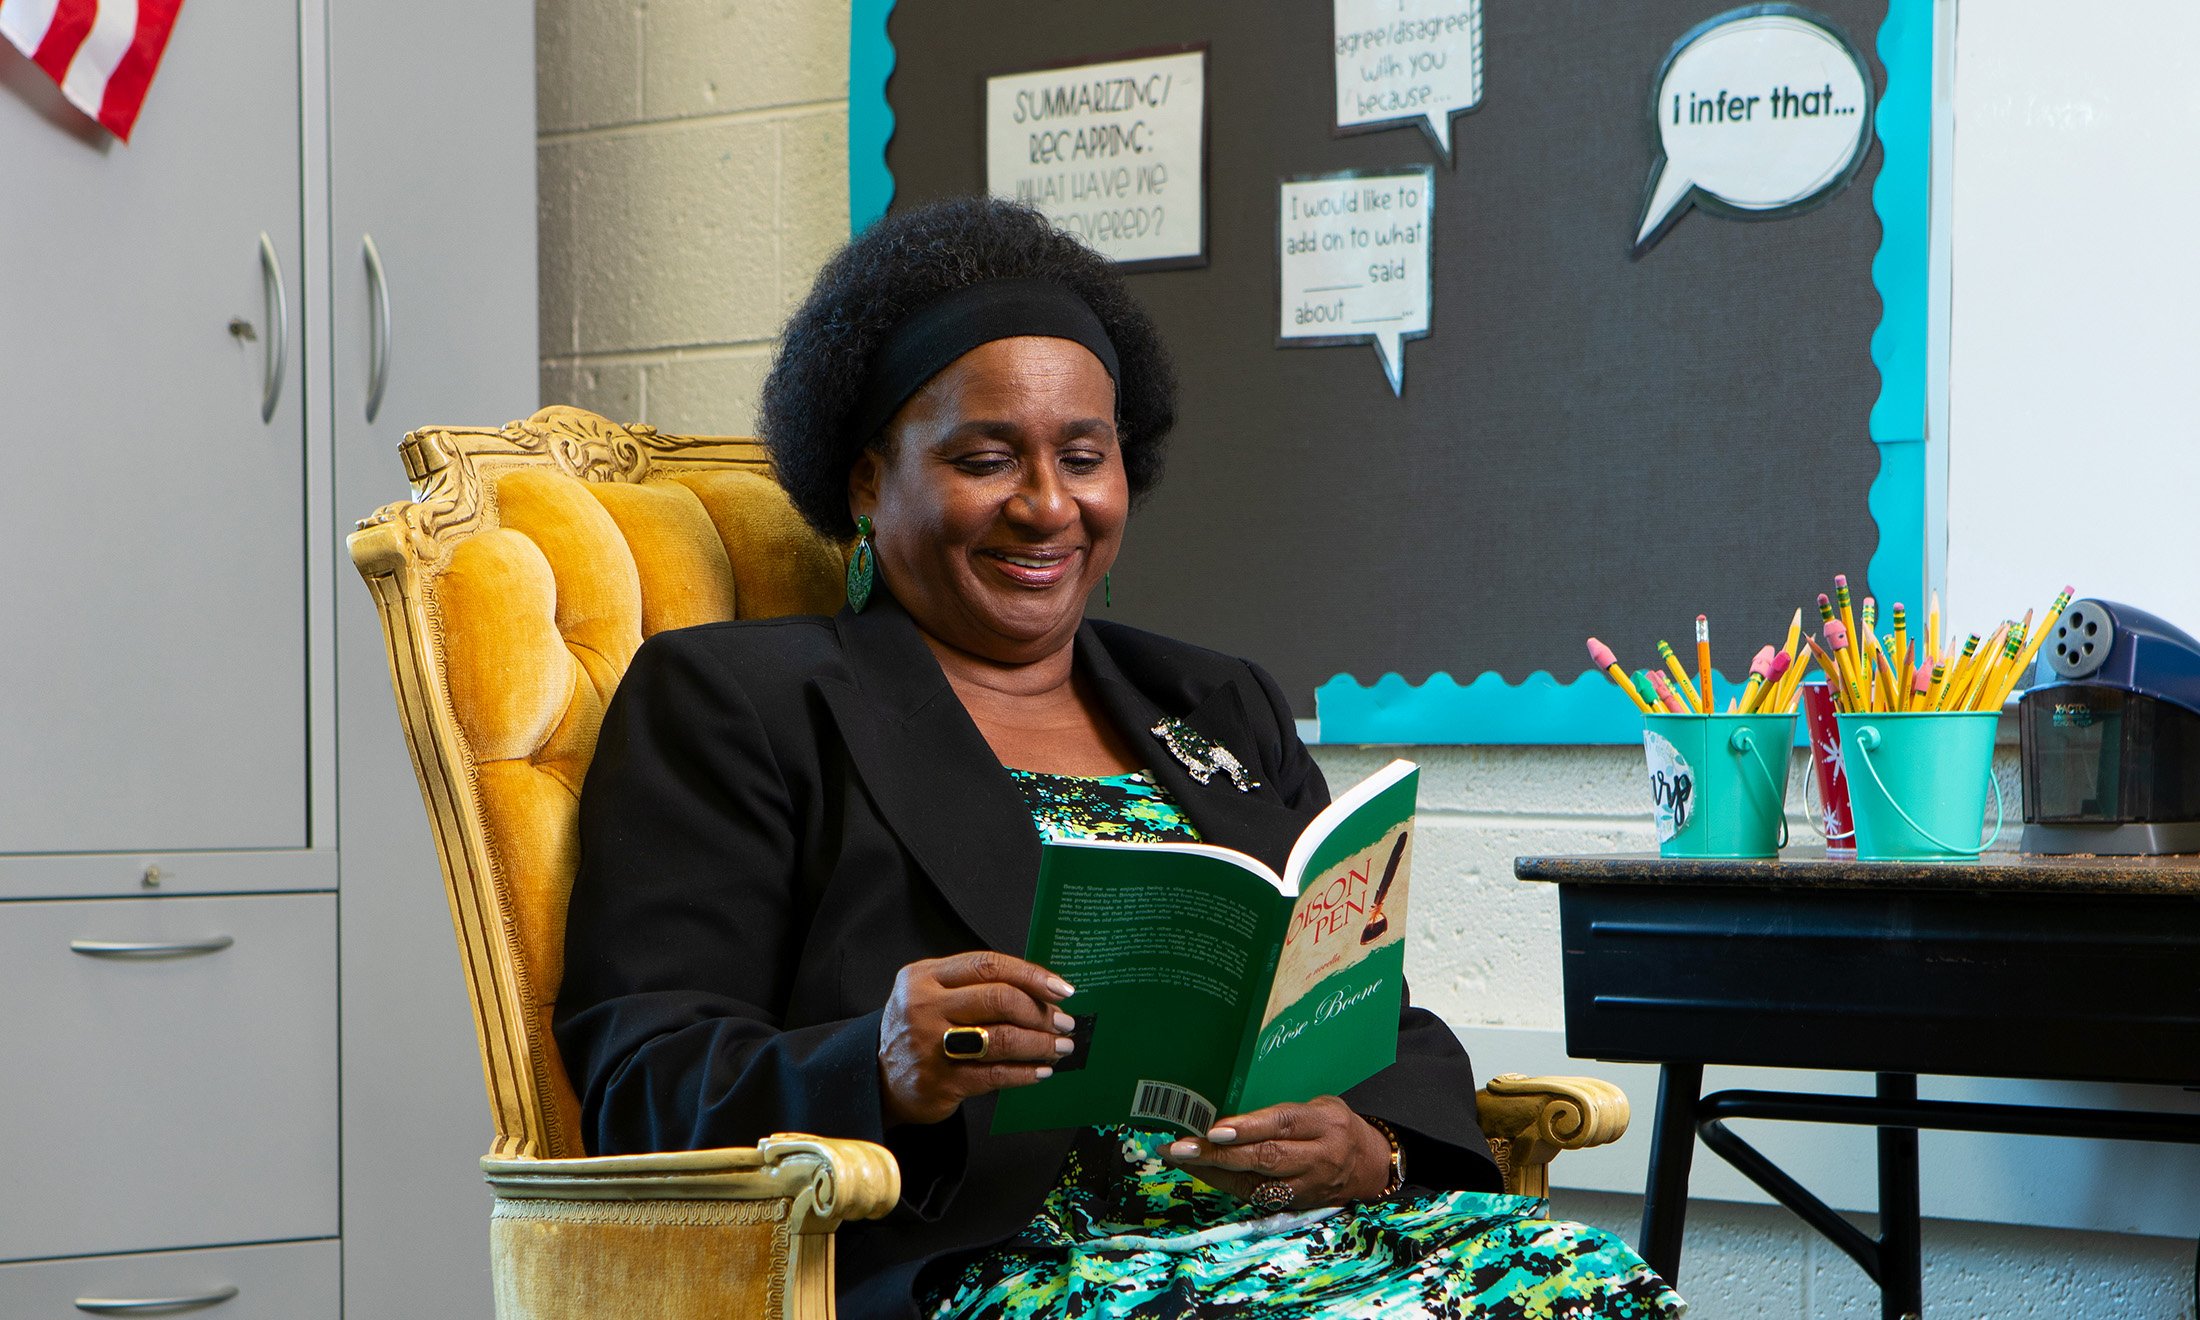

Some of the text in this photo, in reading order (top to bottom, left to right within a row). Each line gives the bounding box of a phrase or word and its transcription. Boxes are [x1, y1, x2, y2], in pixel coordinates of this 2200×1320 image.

[1360, 49, 1446, 81] with you
[1674, 84, 1855, 125] I infer that...
[1292, 186, 1419, 220] I would like to
[1287, 221, 1421, 255] add on to what
[1368, 257, 1405, 283] said
[1295, 299, 1343, 325] about
[1313, 890, 1367, 946] PEN
[1258, 978, 1383, 1062] Rose Boone
